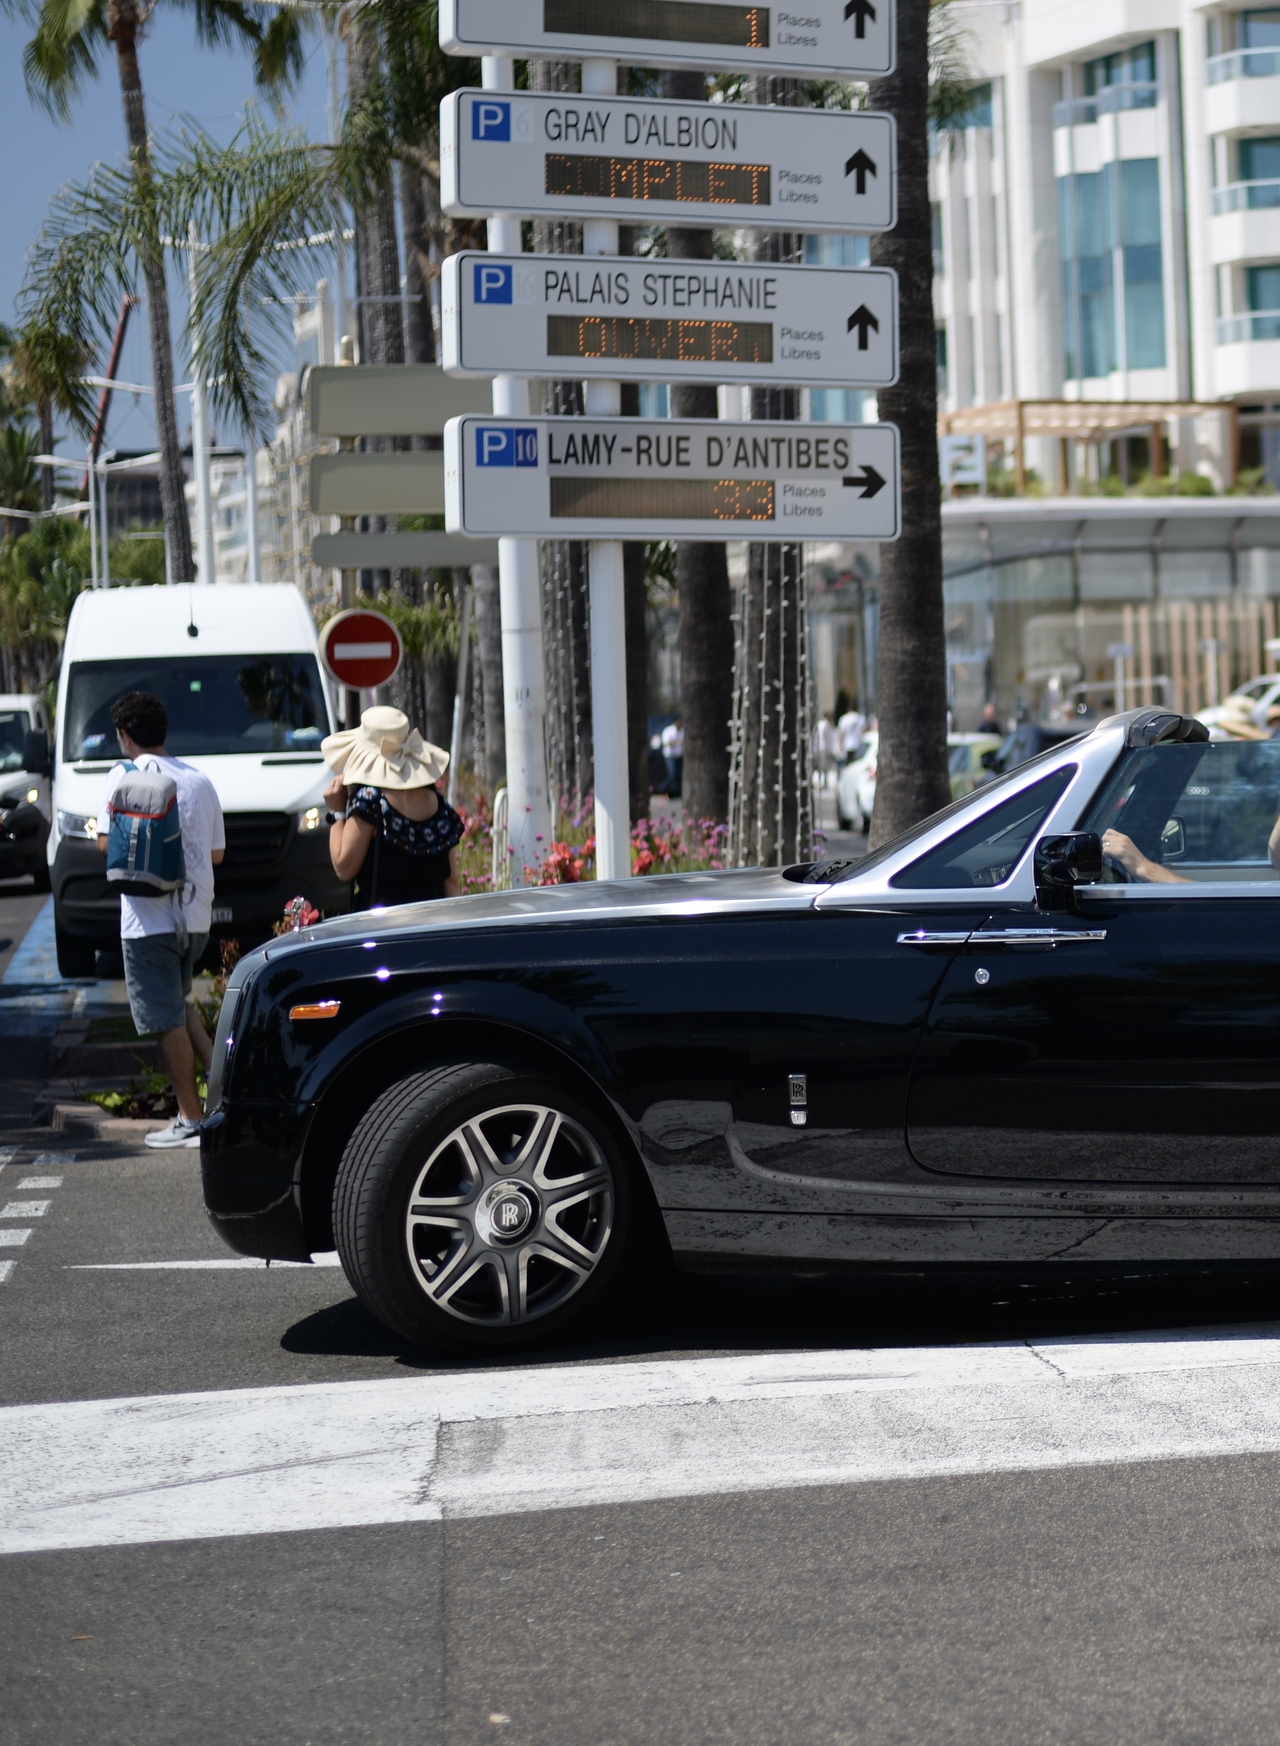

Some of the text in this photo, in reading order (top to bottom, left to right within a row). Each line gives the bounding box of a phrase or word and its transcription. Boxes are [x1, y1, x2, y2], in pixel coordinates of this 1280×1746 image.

[745, 9, 762, 47] 1
[777, 12, 822, 28] Places
[777, 31, 819, 47] Libres
[479, 104, 504, 138] P
[544, 107, 612, 143] GRAY
[624, 112, 738, 150] D'ALBION
[545, 155, 769, 205] COMPLET
[778, 170, 822, 186] Places
[778, 189, 820, 204] Libres
[480, 267, 506, 301] P
[545, 270, 630, 305] PALAIS
[642, 272, 777, 309] STEPHANIE
[780, 326, 825, 342] Places
[780, 347, 822, 361] Libres
[482, 433, 850, 470] P 10 LAMY-RUE D'ANTIBES
[783, 484, 826, 498] Places
[713, 479, 773, 521] 33
[783, 504, 824, 517] Libres
